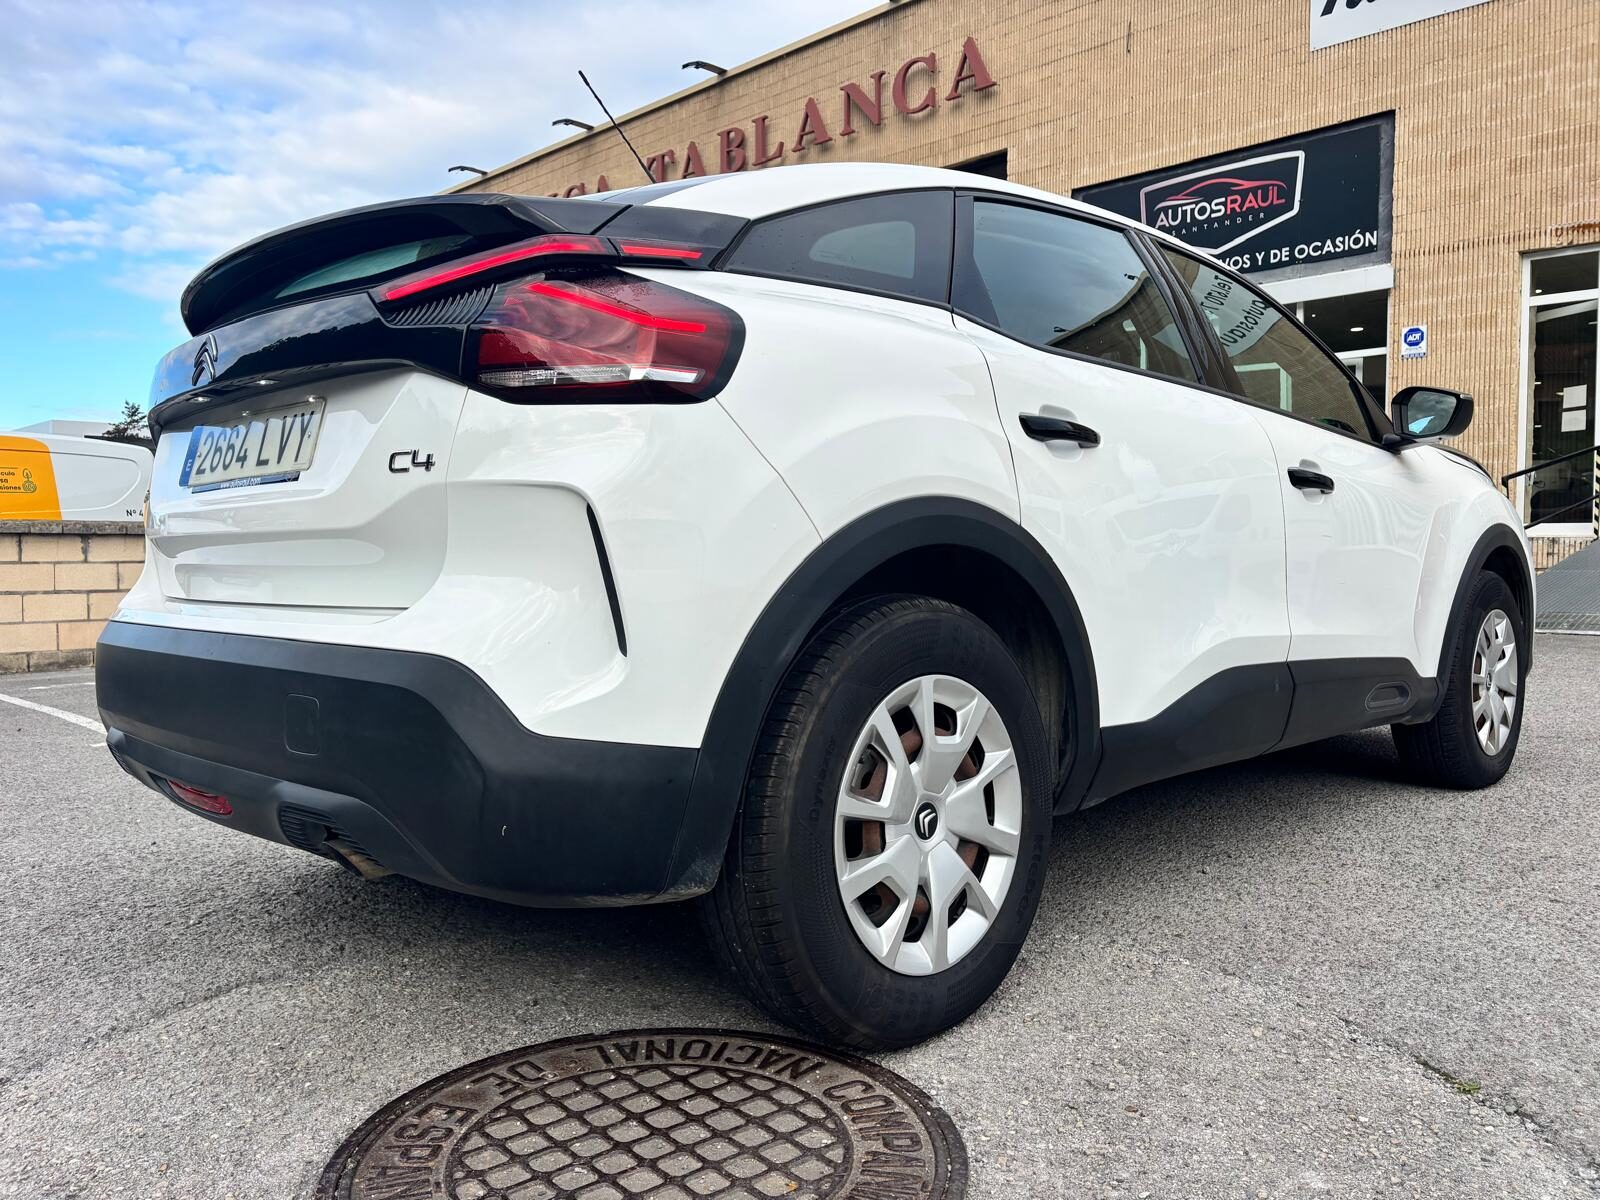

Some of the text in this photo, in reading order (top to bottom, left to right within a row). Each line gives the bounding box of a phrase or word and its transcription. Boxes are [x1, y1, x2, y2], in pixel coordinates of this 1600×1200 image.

[646, 36, 998, 183] TABLANCA
[1172, 212, 1265, 237] SANTANDER
[1255, 251, 1265, 266] Y
[1270, 247, 1290, 264] DE
[1294, 229, 1378, 259] OCASIÓN
[1407, 332, 1422, 343] ADT
[195, 411, 316, 475] 2664 LVY
[388, 449, 436, 473] C4
[186, 459, 193, 471] E
[575, 1038, 828, 1081] NACIONAL
[470, 1060, 548, 1097] DE
